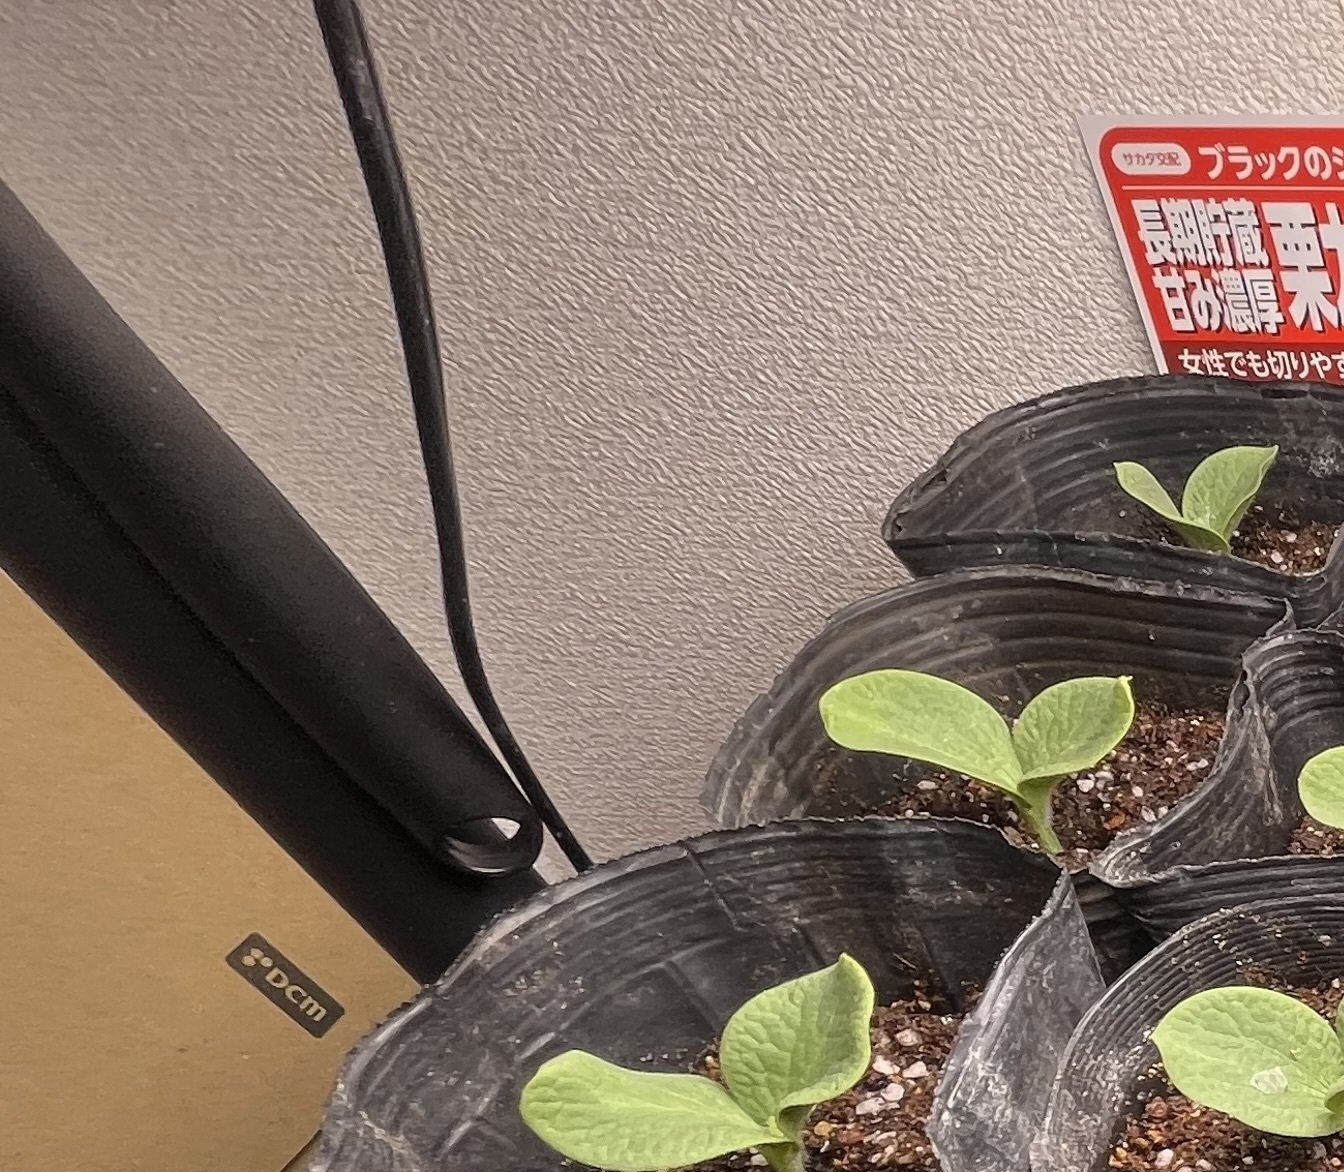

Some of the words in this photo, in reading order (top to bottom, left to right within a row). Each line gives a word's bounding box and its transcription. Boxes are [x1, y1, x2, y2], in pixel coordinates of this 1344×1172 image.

[1123, 151, 1182, 167] サカタ交配
[1130, 197, 1272, 268] 長期貯蔵
[1151, 267, 1286, 335] 甘み濃厚
